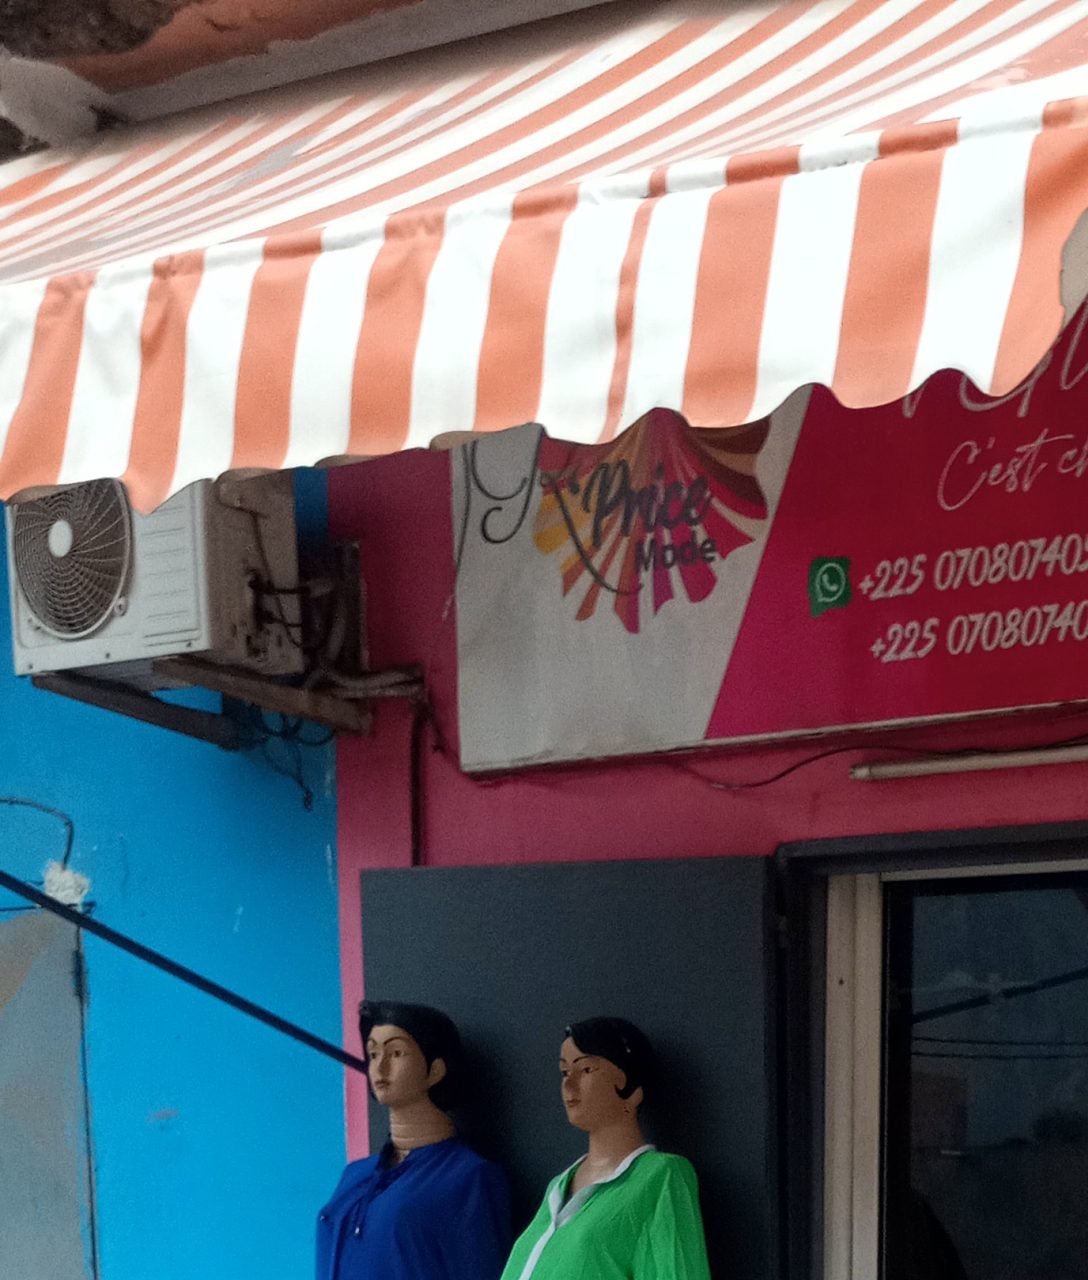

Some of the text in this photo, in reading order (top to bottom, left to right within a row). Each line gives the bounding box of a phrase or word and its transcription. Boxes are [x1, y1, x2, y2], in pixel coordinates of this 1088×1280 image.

[938, 429, 1074, 511] C'est
[635, 534, 718, 573] Mode
[858, 553, 928, 601] +225
[869, 616, 940, 664] +225
